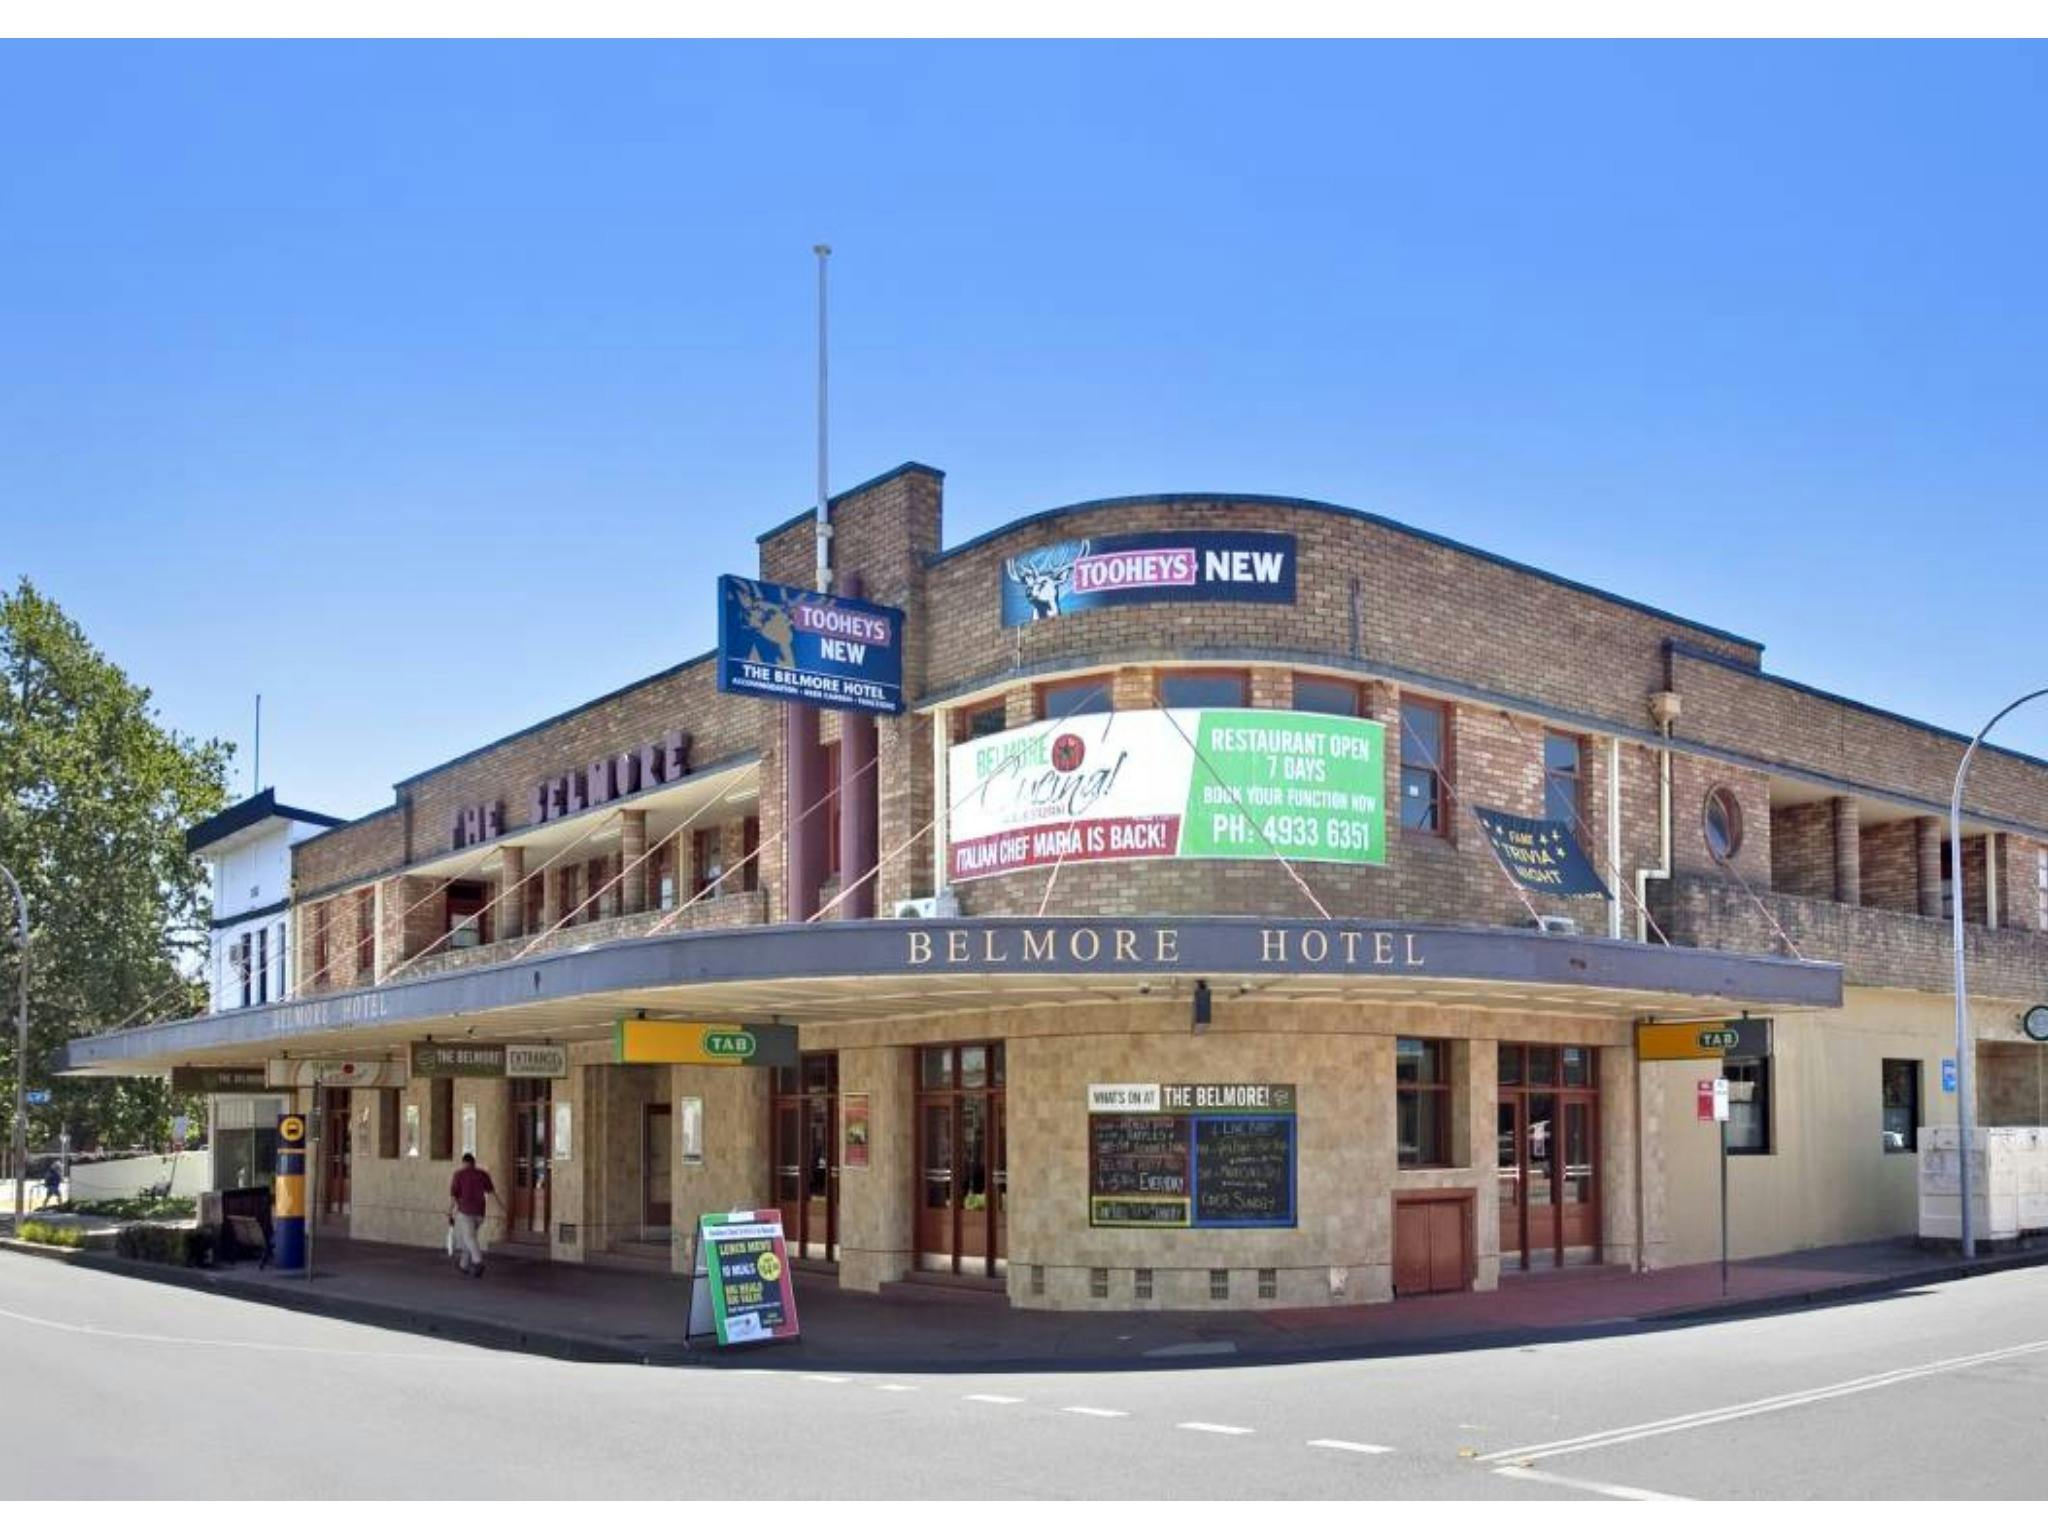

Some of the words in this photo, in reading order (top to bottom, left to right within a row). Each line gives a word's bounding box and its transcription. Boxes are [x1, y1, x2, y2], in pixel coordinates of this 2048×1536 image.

[1079, 555, 1188, 587] TOOHEYS
[1205, 550, 1284, 583] NEW
[801, 606, 885, 640] TOOHEYS
[821, 638, 866, 665] NEW
[743, 664, 770, 680] THE
[774, 670, 839, 692] BELMORE
[844, 683, 886, 700] HOTEL
[977, 736, 1048, 779] BELMORE
[1211, 728, 1326, 756] RESTAURANT
[1330, 735, 1370, 762] OPEN
[1267, 755, 1277, 780] 7
[1284, 756, 1325, 782] DAYS
[1204, 786, 1242, 805] BOOK
[1247, 786, 1283, 807] YOUR
[1288, 789, 1348, 810] FUNCTION
[1352, 793, 1376, 813] NOW
[1213, 814, 1254, 843] PH:
[1263, 815, 1319, 846] 4933
[1326, 818, 1369, 850] 6351
[956, 843, 997, 873] ITALIAN
[1000, 835, 1030, 865] CHEF
[1033, 828, 1082, 857] MARIA
[1087, 826, 1104, 851] IS
[1110, 824, 1166, 850] BACK!
[1501, 842, 1556, 864] TRIVIA
[1513, 864, 1562, 884] NIGHT
[907, 929, 1179, 964] BELMORE
[1261, 929, 1425, 966] HOTEL
[343, 994, 387, 1019] HOTEL
[712, 1038, 747, 1051] TAB
[1704, 1034, 1733, 1045] TAB
[437, 1050, 455, 1063] THE
[1093, 1091, 1126, 1105] WHAT'S
[1128, 1091, 1141, 1105] ON
[1144, 1090, 1155, 1105] AT
[1163, 1087, 1191, 1106] THE
[1196, 1086, 1269, 1107] BELMORE!
